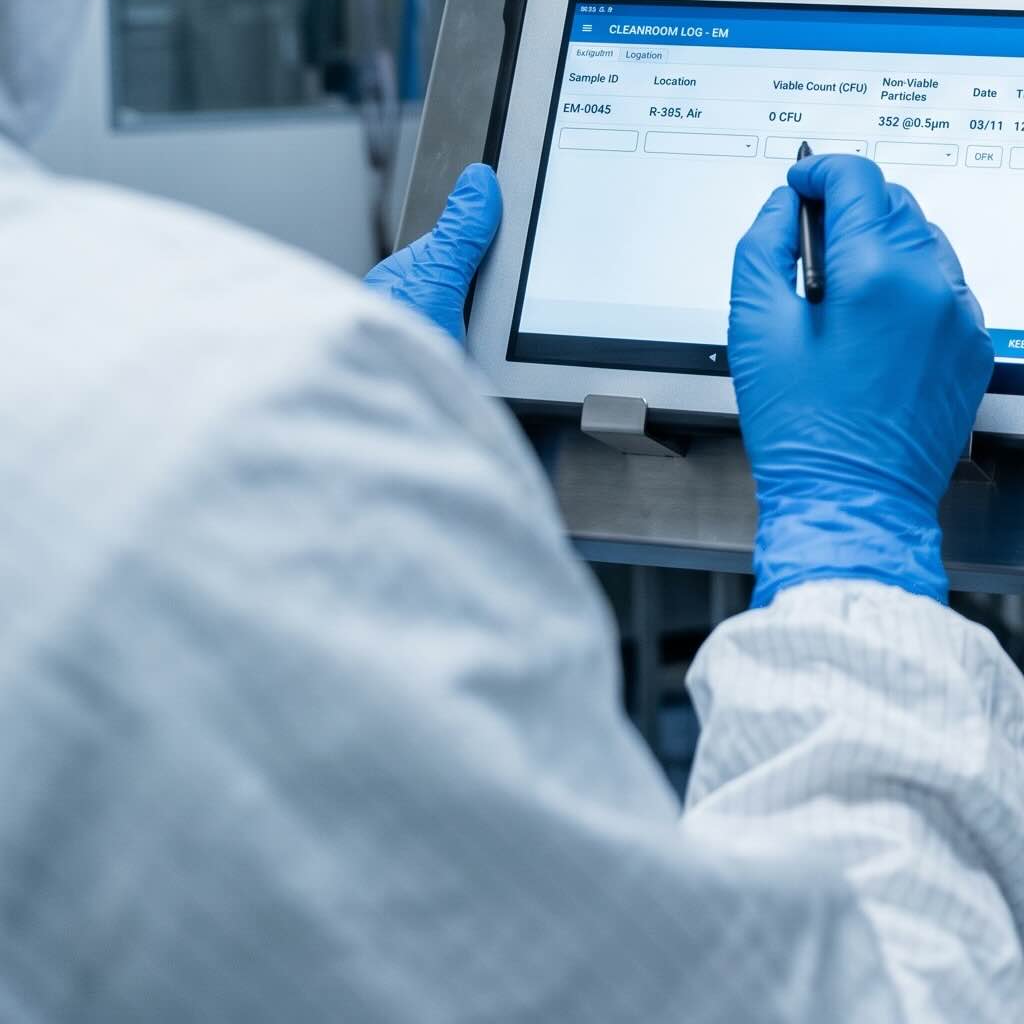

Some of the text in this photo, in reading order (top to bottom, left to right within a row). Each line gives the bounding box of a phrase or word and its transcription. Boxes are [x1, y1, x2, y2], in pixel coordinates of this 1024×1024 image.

[609, 24, 678, 37] CLEANROOM
[681, 27, 702, 38] LOG
[712, 28, 729, 38] EM
[569, 72, 619, 85] Sample ID
[654, 76, 696, 87] Location
[882, 77, 938, 89] Non-Viable
[773, 81, 867, 94] Viable Count (CFU)
[973, 88, 997, 97] Date
[881, 91, 927, 102] Particles
[563, 103, 611, 114] EM-0045
[686, 108, 703, 118] Air
[769, 111, 802, 122] 0 CFU
[878, 116, 950, 131] 352 @0.5µm
[970, 120, 1003, 131] 03/11
